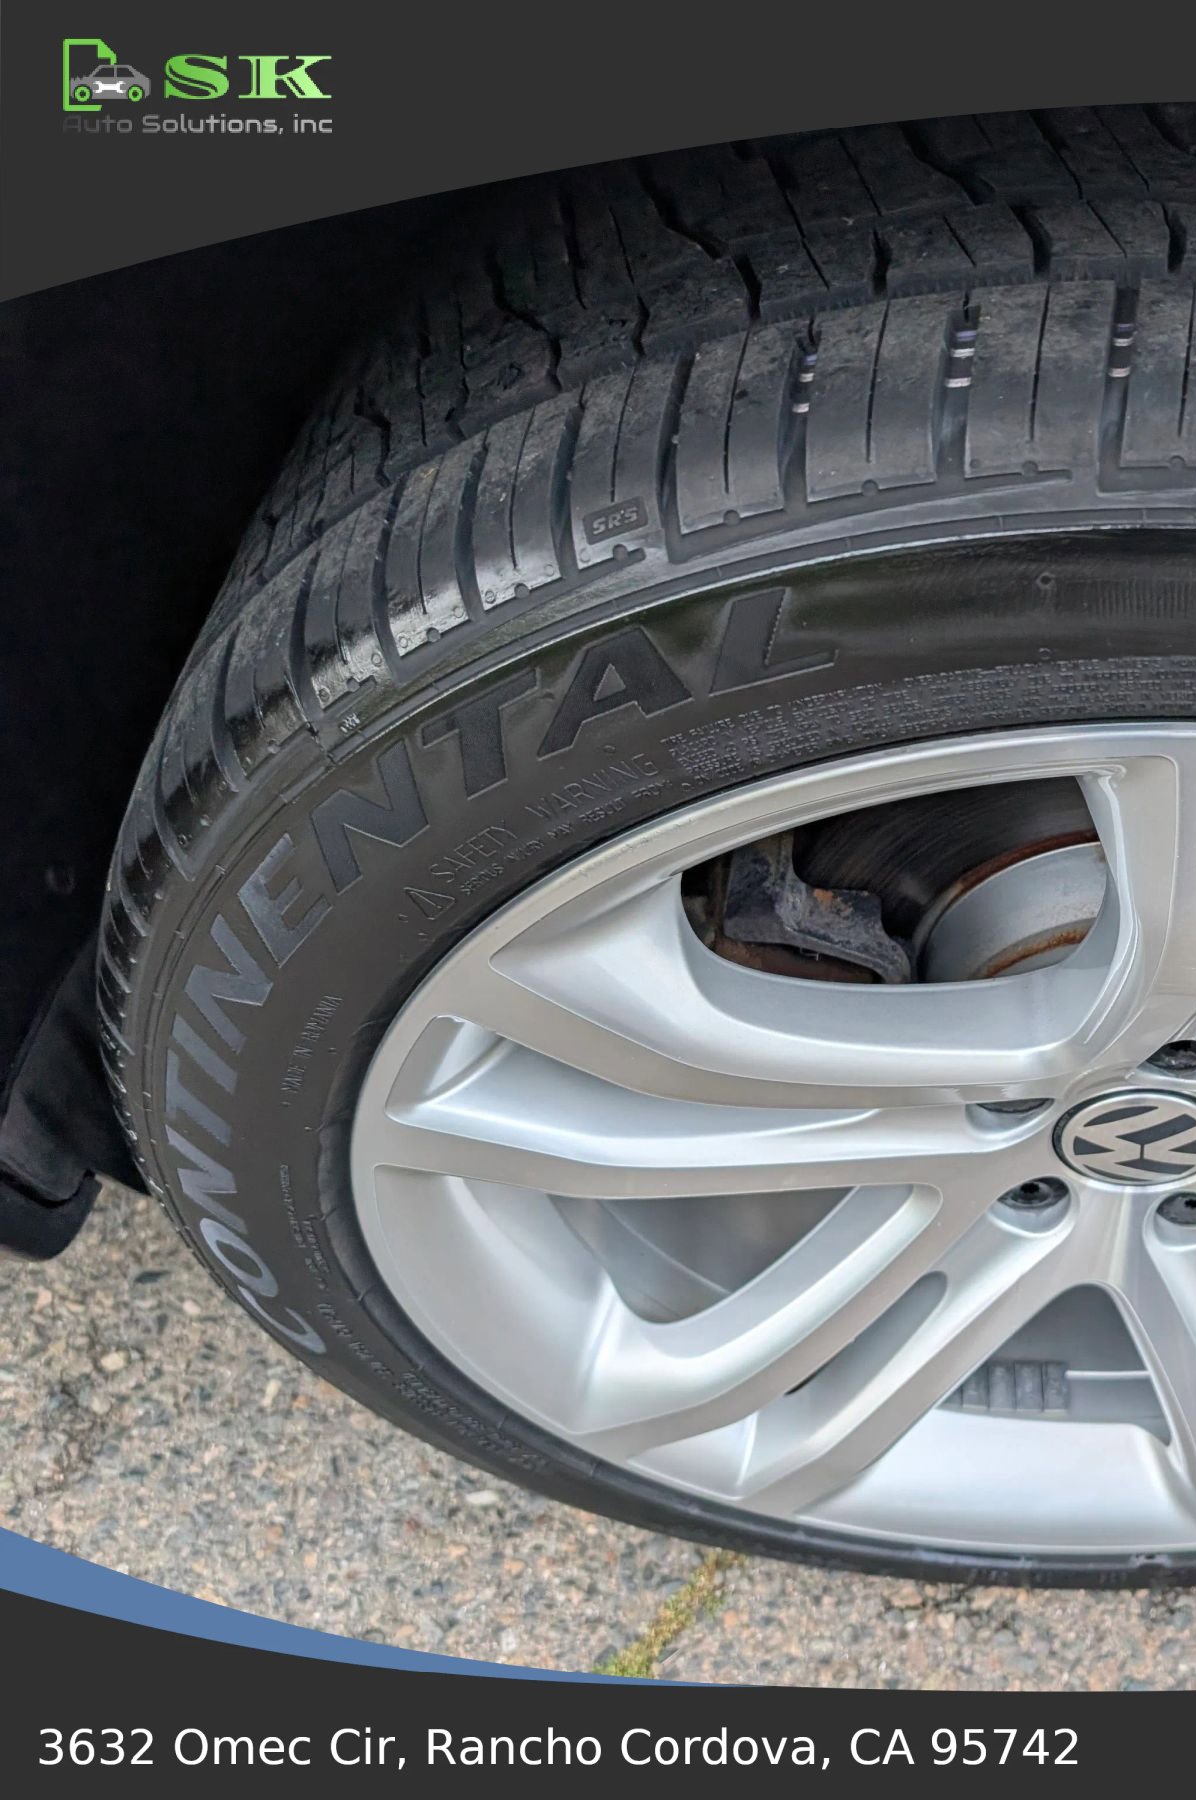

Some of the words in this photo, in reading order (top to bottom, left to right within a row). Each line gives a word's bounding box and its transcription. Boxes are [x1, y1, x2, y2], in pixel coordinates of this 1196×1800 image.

[165, 587, 838, 1354] CONTINENTAL
[429, 820, 518, 884] SAFETY
[523, 753, 659, 819] WARNING
